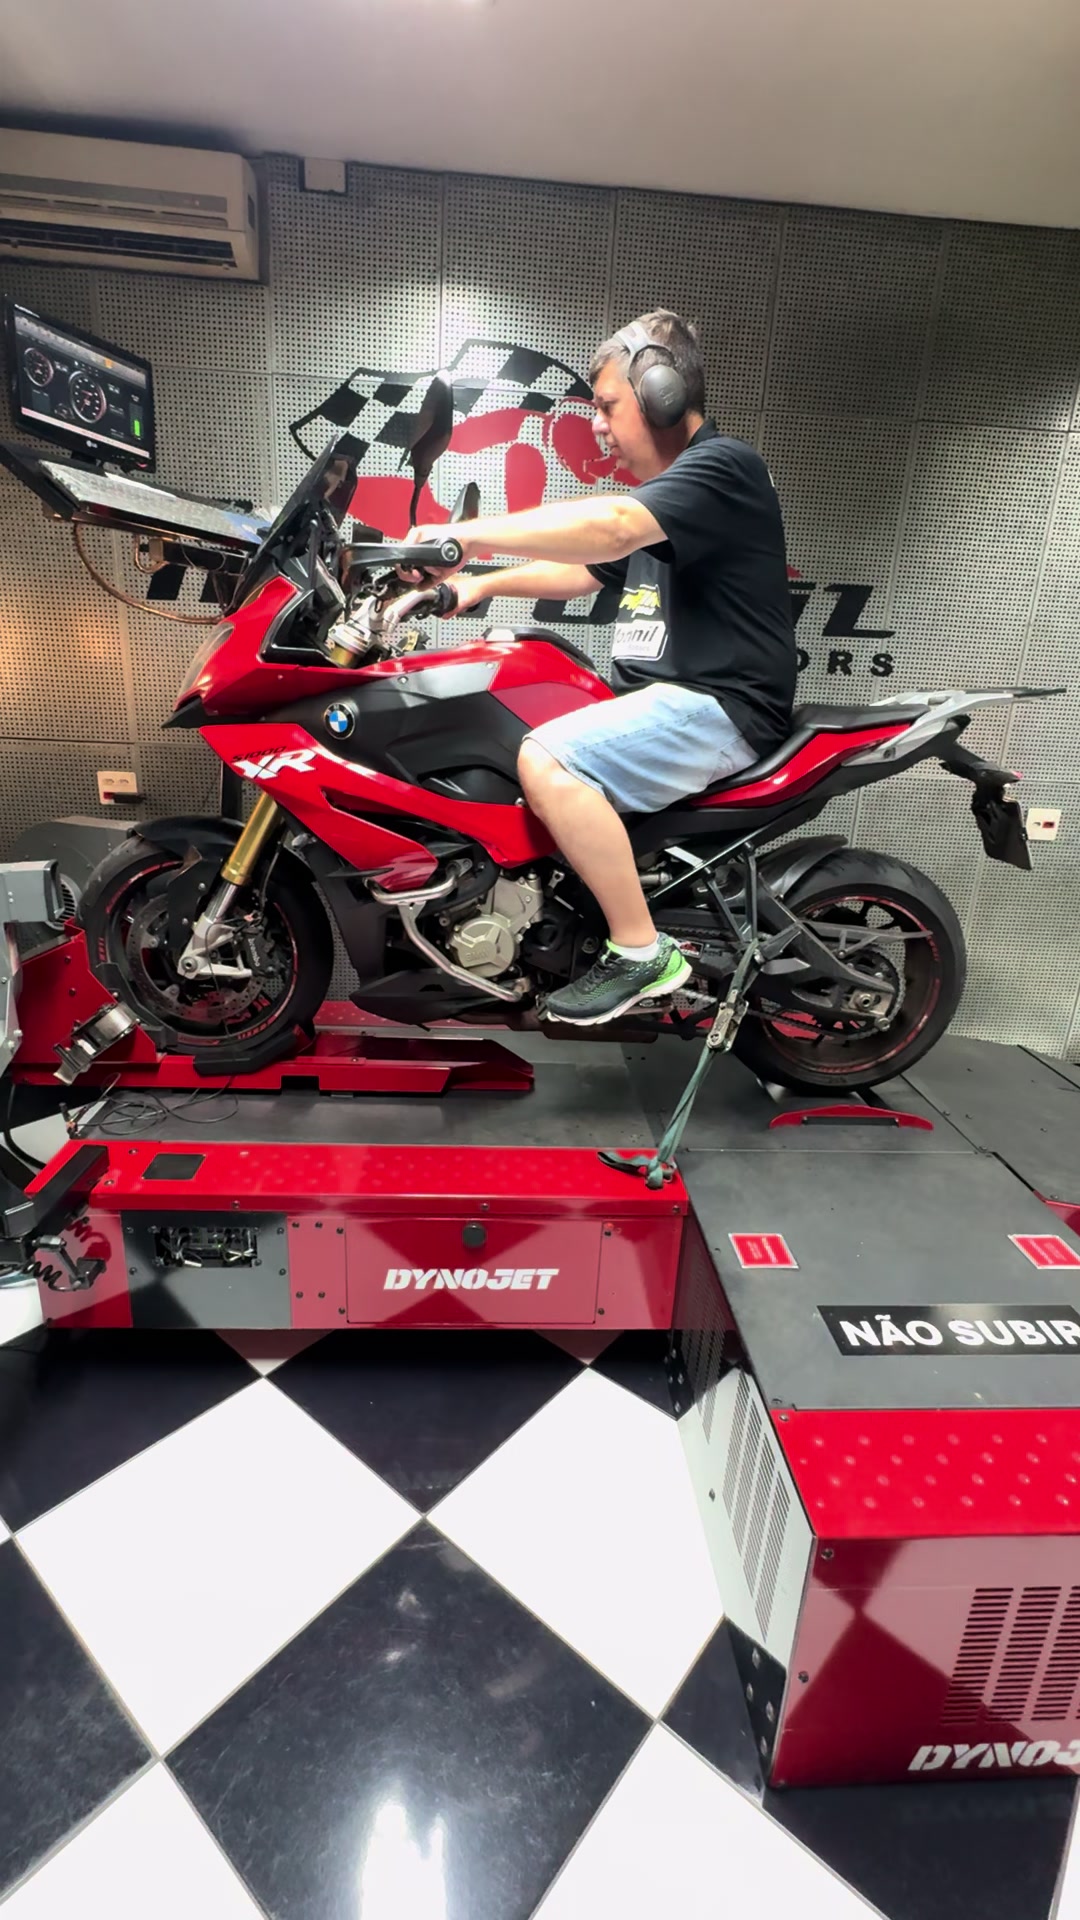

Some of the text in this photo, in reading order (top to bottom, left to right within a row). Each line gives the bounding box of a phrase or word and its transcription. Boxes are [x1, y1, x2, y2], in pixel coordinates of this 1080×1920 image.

[231, 748, 317, 780] XR
[232, 746, 287, 762] S1000
[383, 1268, 560, 1290] DYNOJET
[839, 1314, 1080, 1346] NÃO SUBIR
